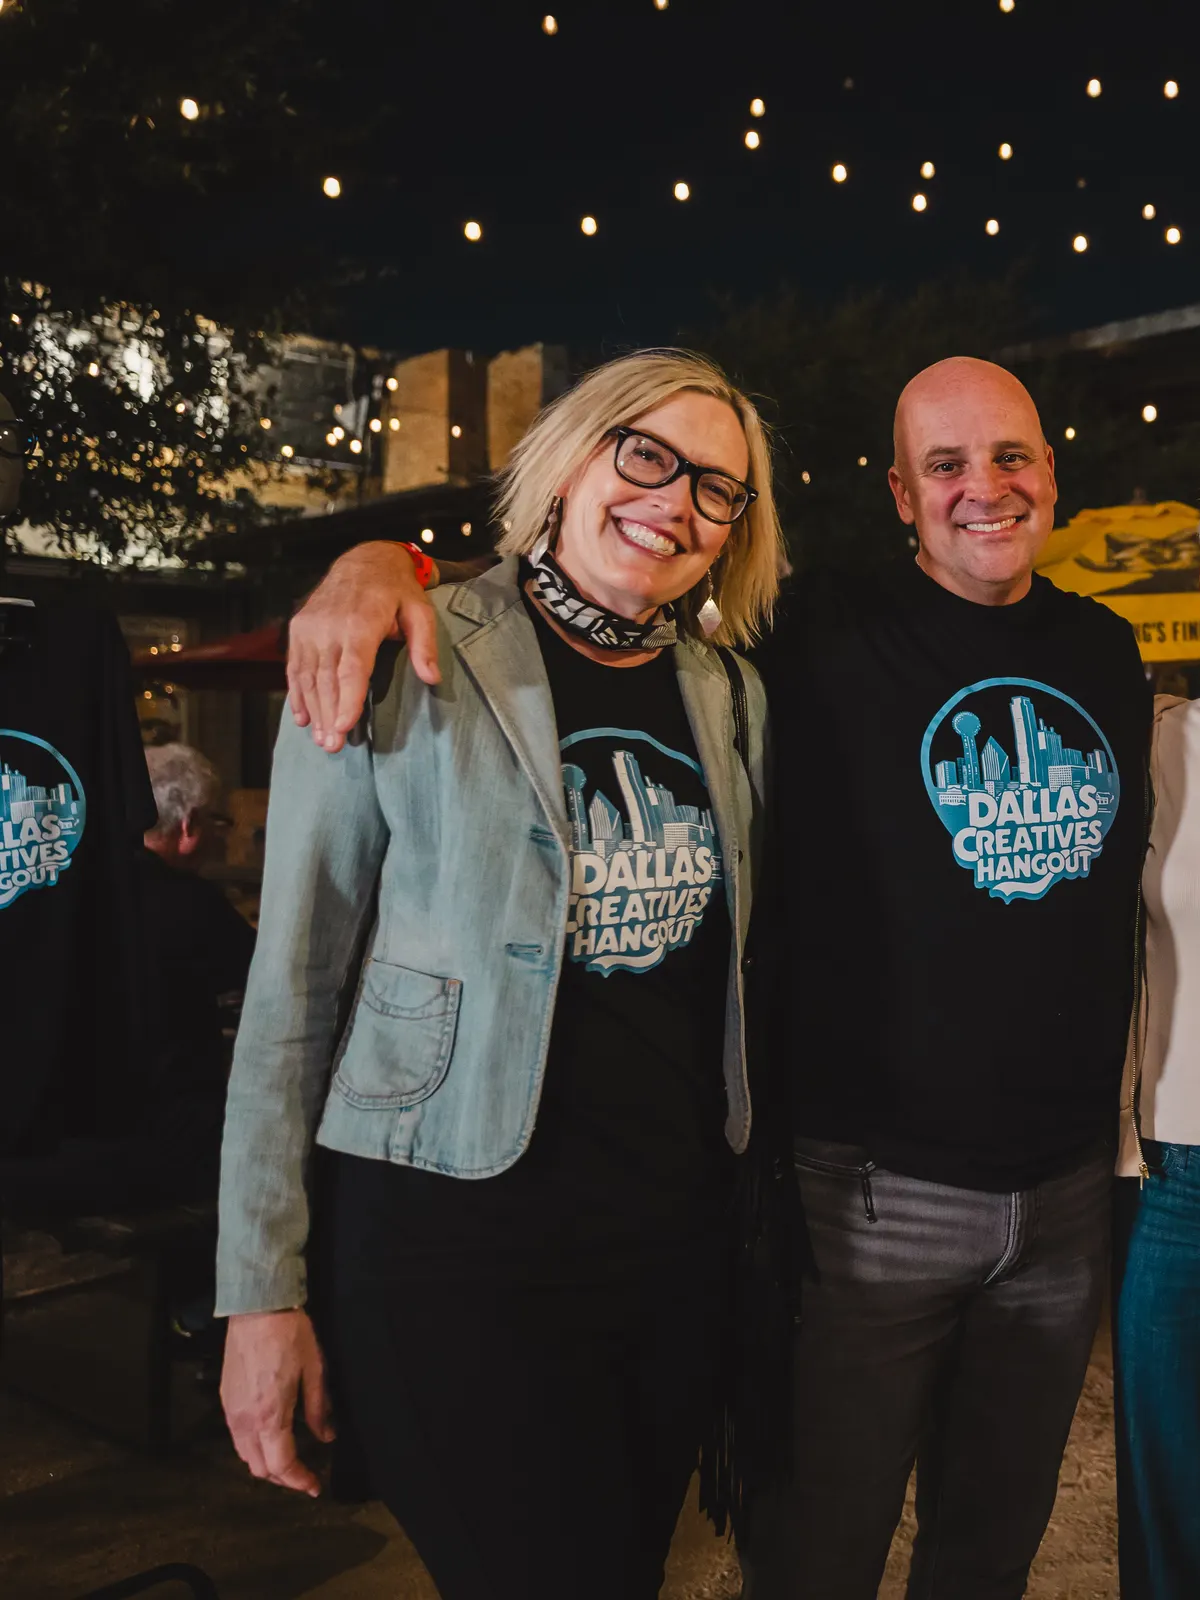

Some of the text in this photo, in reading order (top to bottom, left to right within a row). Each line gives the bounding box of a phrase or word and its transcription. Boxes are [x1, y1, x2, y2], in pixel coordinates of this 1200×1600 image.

[968, 784, 1098, 828] DALLAS
[0, 814, 61, 850] LAS
[953, 820, 1102, 862] CREATIVES
[572, 846, 712, 895] DALLAS
[977, 850, 1092, 882] HANGOUT
[573, 918, 695, 956] HANGOUT
